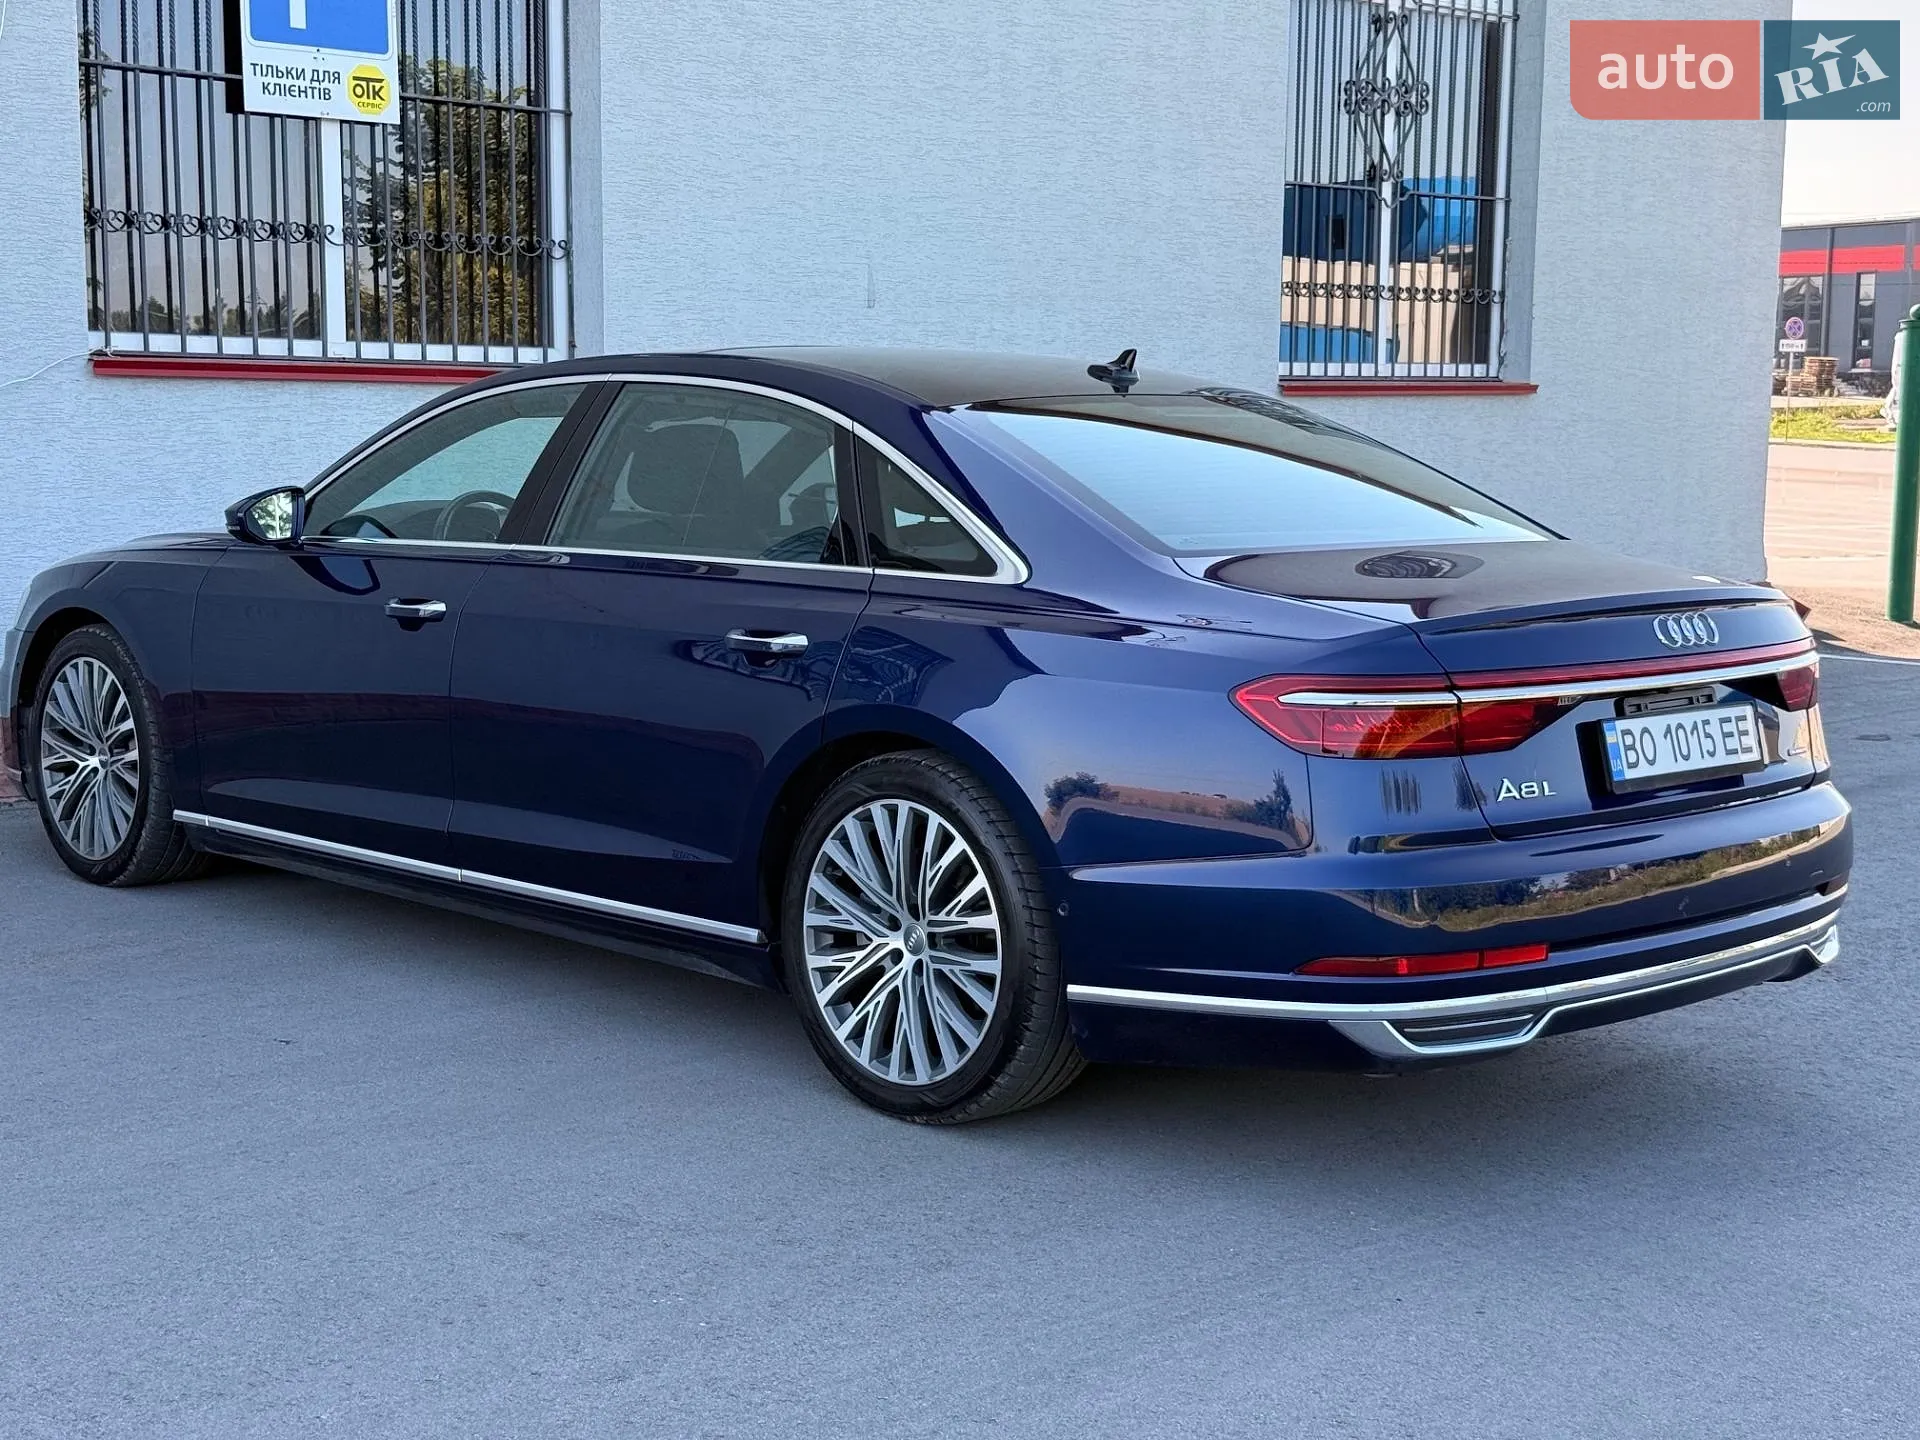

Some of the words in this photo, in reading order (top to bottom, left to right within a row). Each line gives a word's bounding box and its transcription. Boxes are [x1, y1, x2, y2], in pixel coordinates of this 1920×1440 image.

[250, 62, 306, 82] ТІЛЬКИ
[310, 69, 341, 85] ДЛЯ
[262, 82, 332, 101] КЛІЄНТІВ
[352, 75, 386, 101] ОТК
[1620, 728, 1657, 770] BO
[1663, 718, 1717, 764] 1015
[1718, 714, 1753, 756] EE
[1611, 758, 1623, 772] UA
